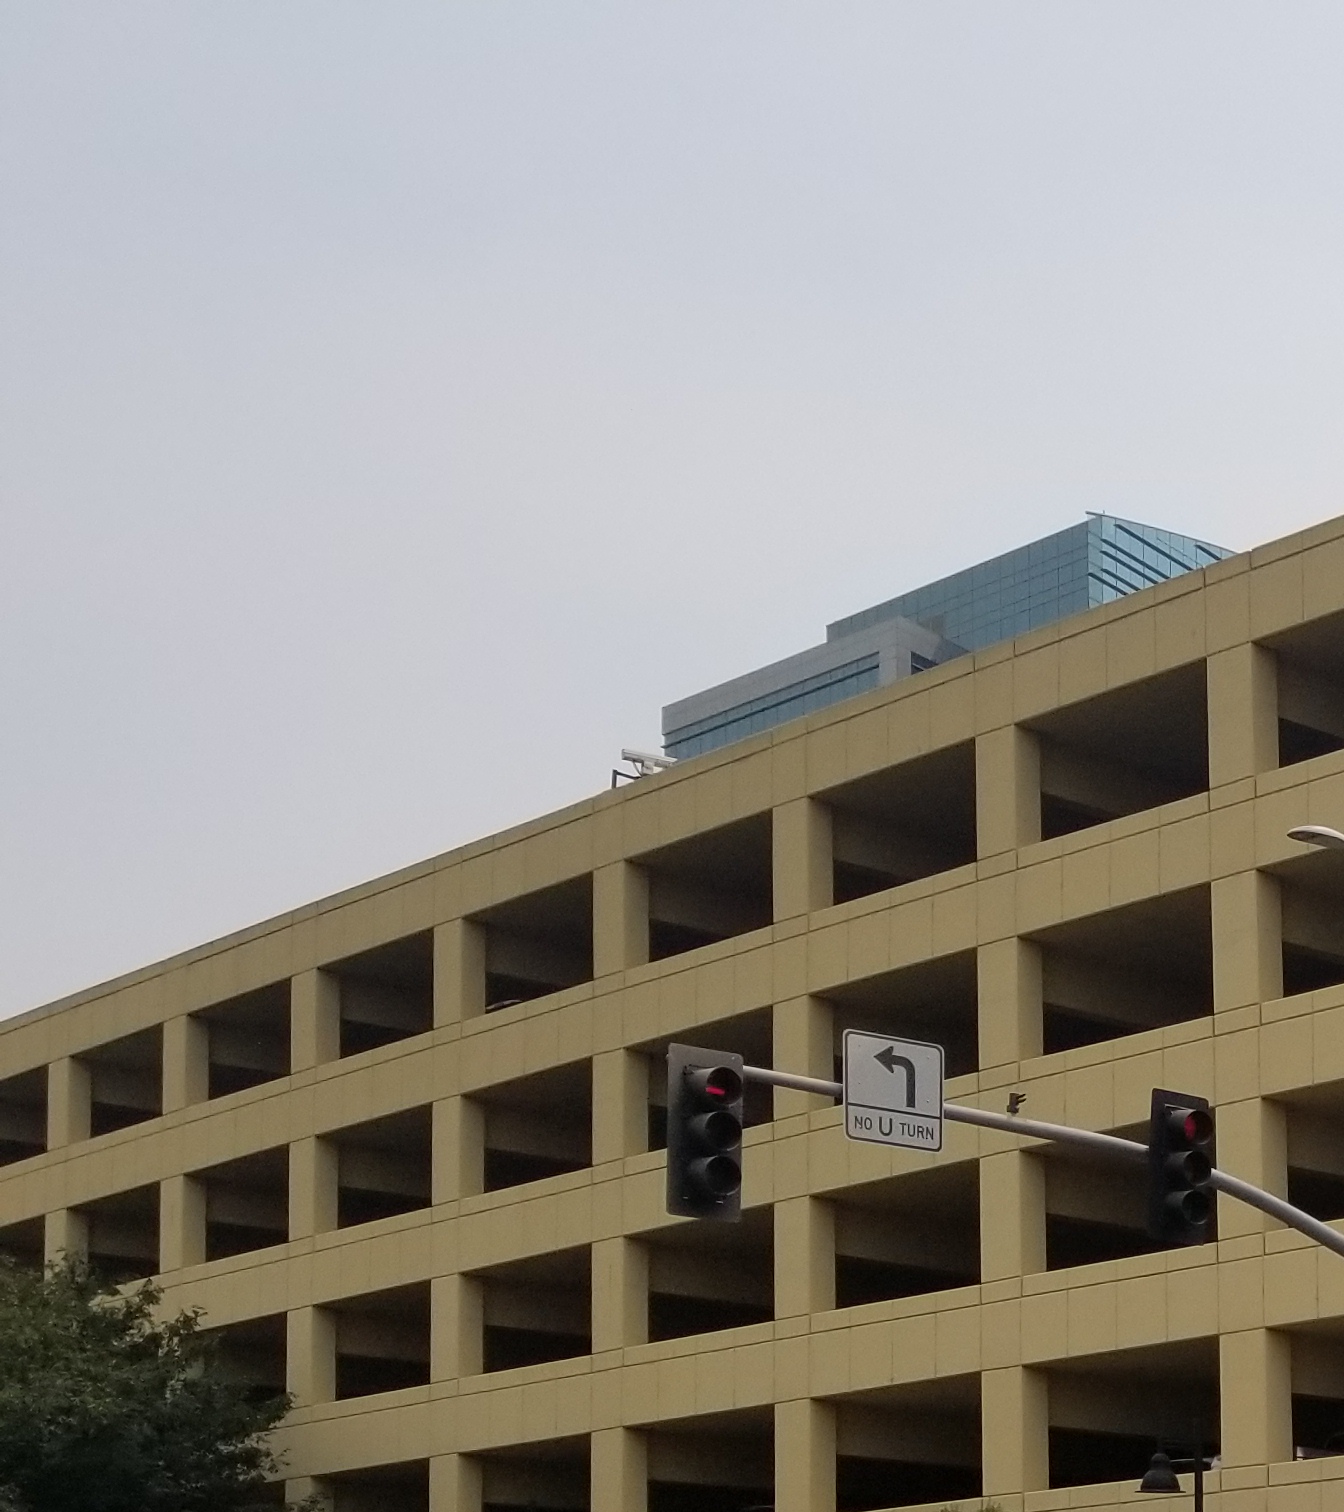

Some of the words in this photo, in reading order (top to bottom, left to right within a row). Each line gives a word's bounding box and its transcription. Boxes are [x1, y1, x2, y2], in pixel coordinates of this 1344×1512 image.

[854, 1115, 873, 1130] NO
[879, 1116, 893, 1136] U
[898, 1122, 934, 1140] TURN
